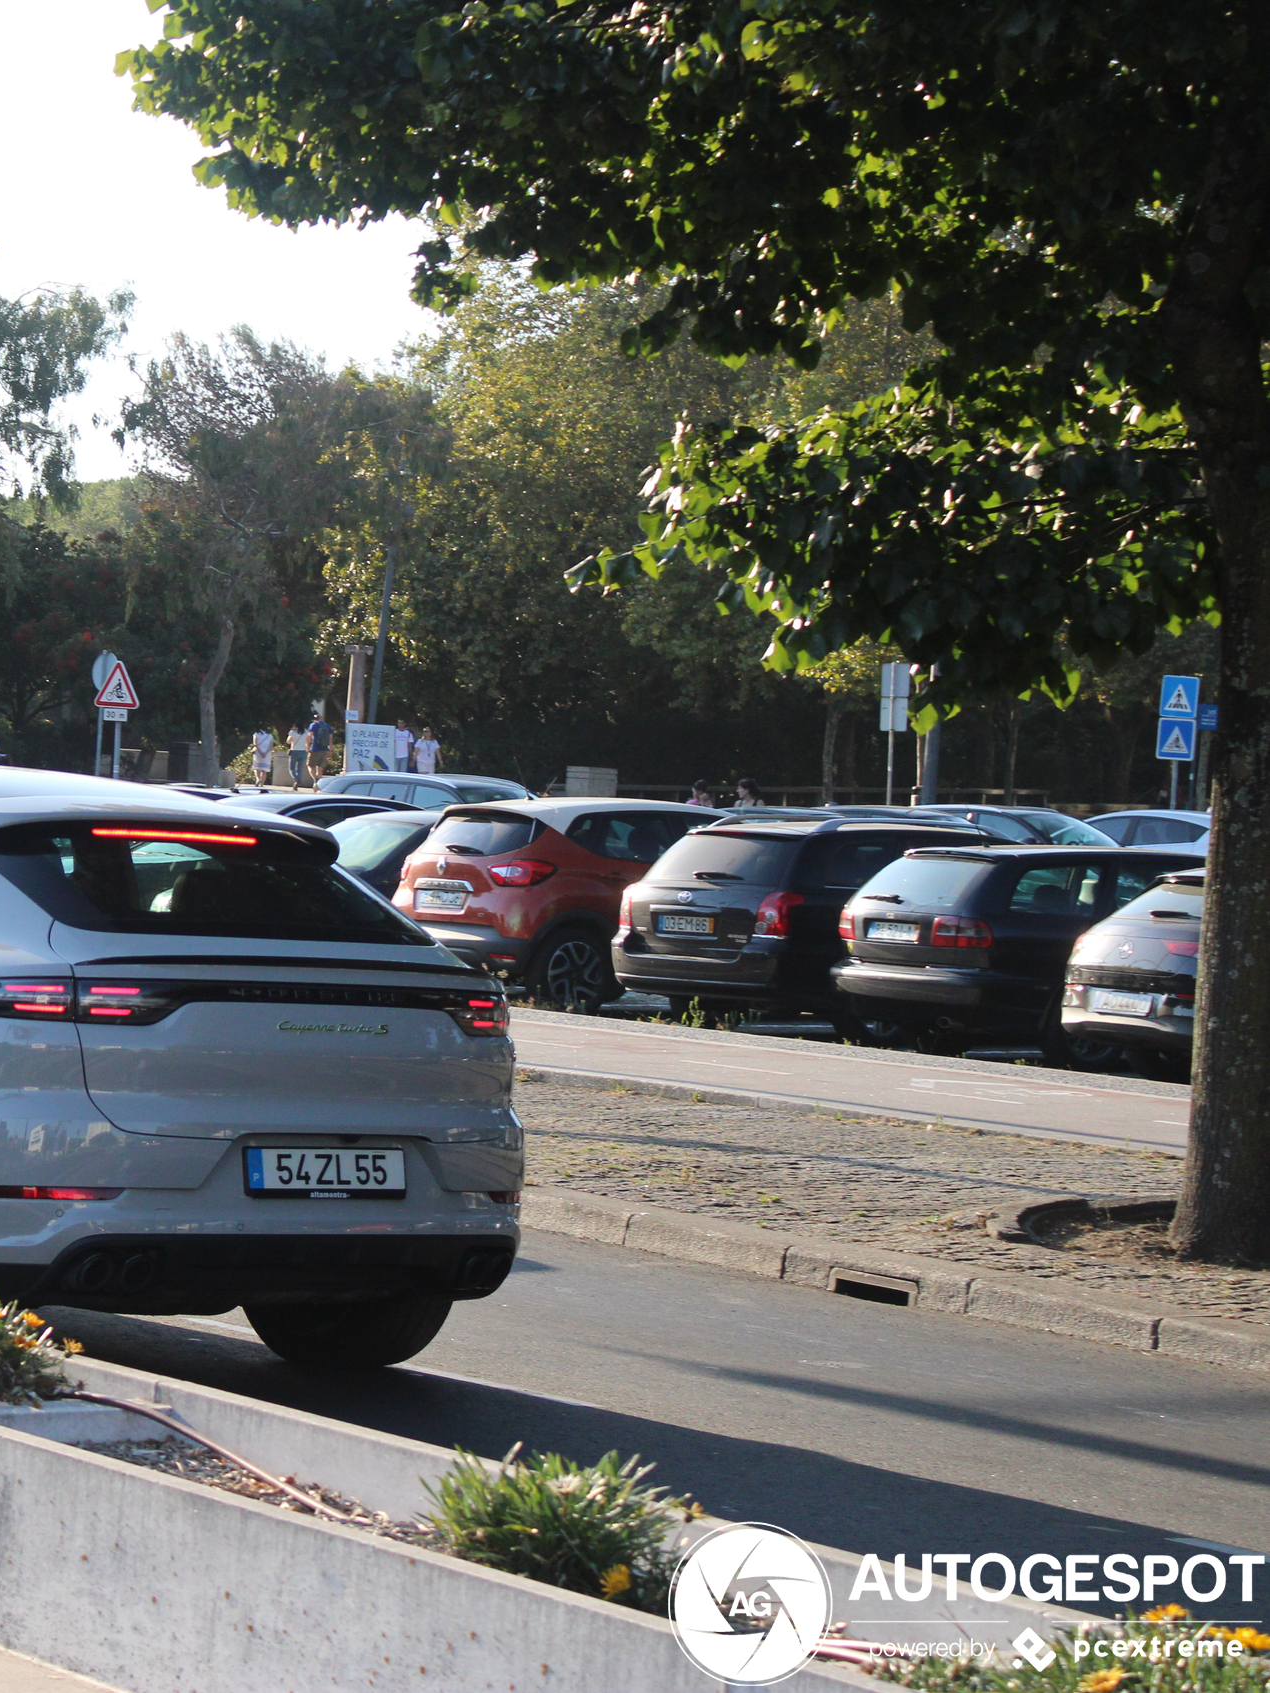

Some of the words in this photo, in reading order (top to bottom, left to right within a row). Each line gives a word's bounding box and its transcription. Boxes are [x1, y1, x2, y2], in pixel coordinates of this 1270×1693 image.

[106, 710, 115, 718] 30
[359, 730, 389, 739] PLANETA
[352, 739, 378, 747] PRECISA
[352, 748, 370, 759] PAZ
[276, 1021, 335, 1035] Cayenne
[337, 1023, 372, 1033] Turbo
[373, 1024, 389, 1035] S
